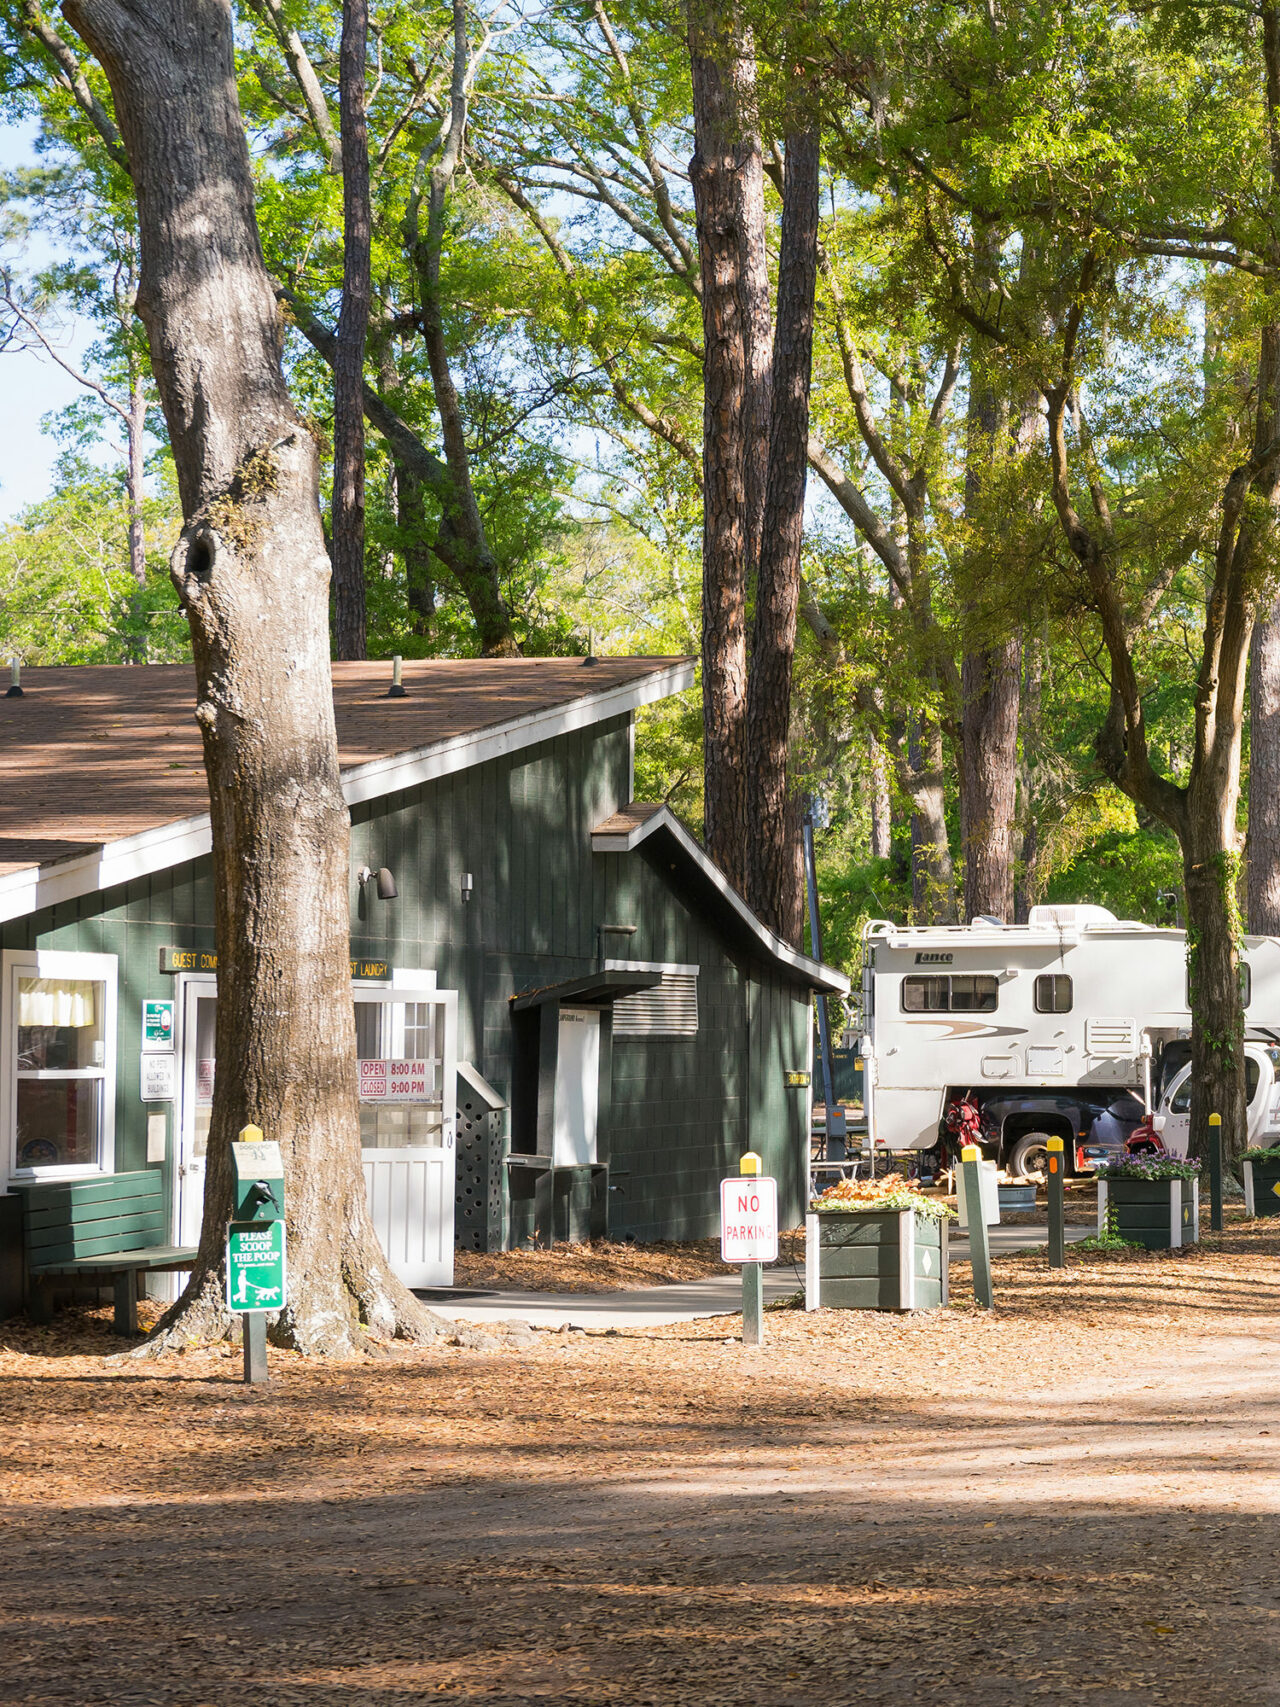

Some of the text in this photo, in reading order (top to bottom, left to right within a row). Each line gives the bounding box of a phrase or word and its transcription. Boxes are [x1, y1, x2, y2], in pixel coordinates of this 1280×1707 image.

[172, 952, 197, 968] GUEST
[914, 952, 953, 964] Lance
[360, 962, 387, 976] LAUNDRY
[362, 1063, 425, 1075] OPEN 8:00 AM
[362, 1081, 425, 1093] CLOSED 9:00 PM
[738, 1195, 760, 1213] NO
[239, 1231, 273, 1241] PLEASE
[726, 1225, 773, 1240] PARKING
[240, 1241, 273, 1252] SCOOP
[232, 1251, 281, 1263] THE POOP
